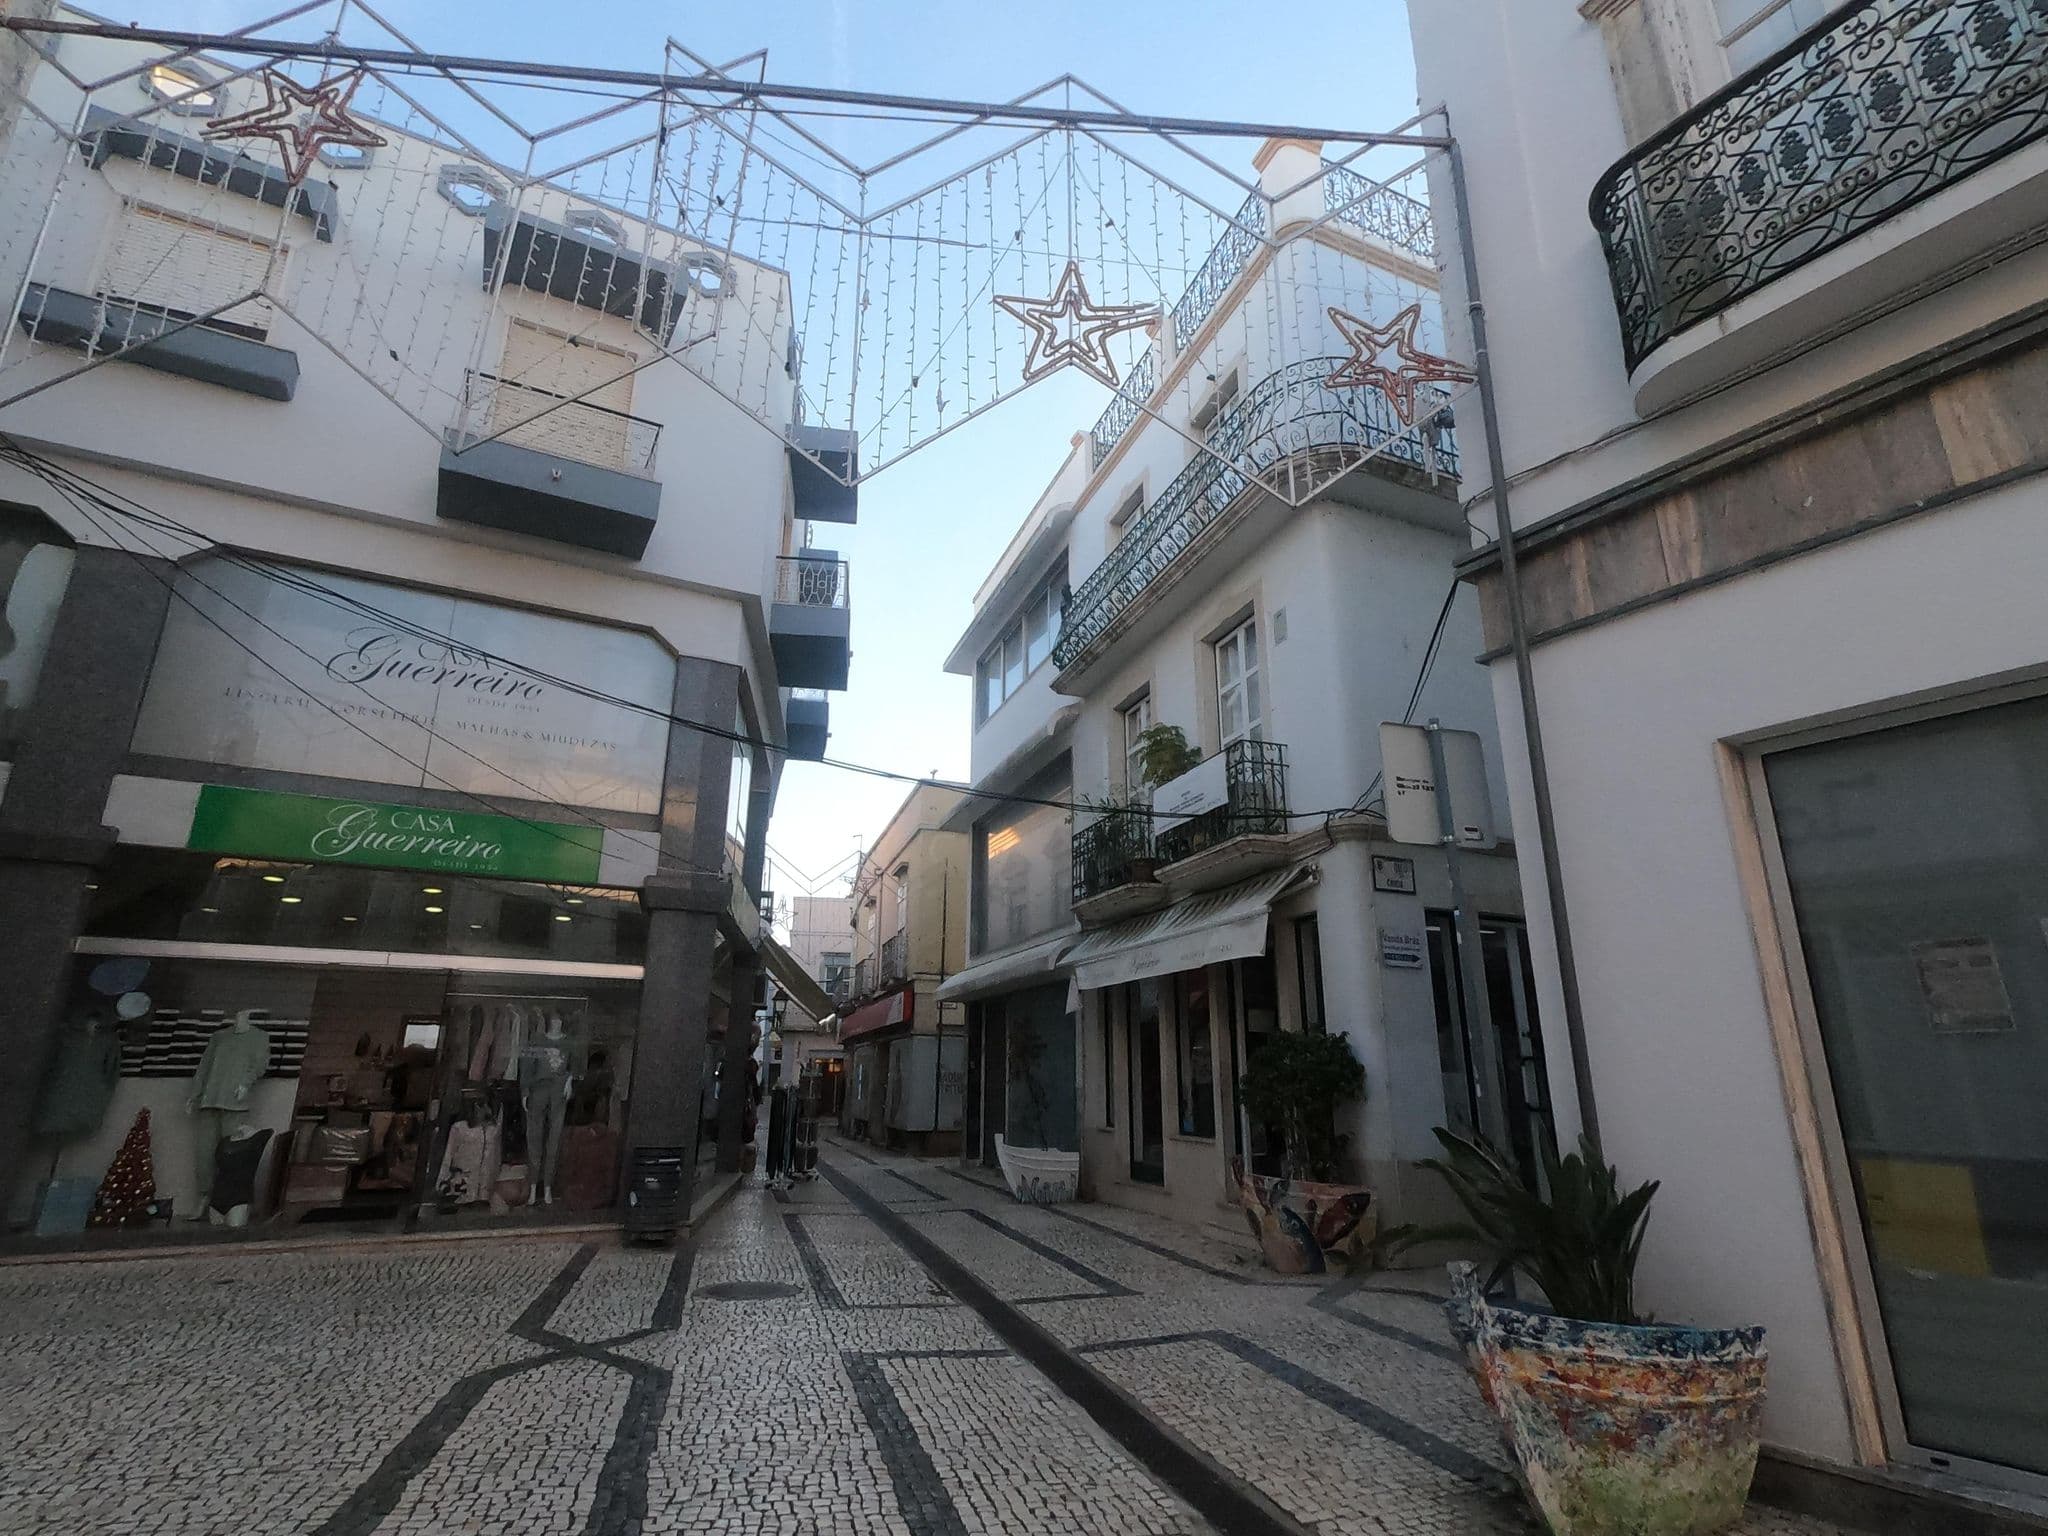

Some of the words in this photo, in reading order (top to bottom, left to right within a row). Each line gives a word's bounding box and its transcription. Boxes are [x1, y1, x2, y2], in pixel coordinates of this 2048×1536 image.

[327, 626, 544, 700] Guerreiro
[419, 641, 491, 670] CASA
[456, 720, 520, 738] MALHAS
[311, 804, 503, 860] Guerreiro
[391, 811, 456, 834] CASA
